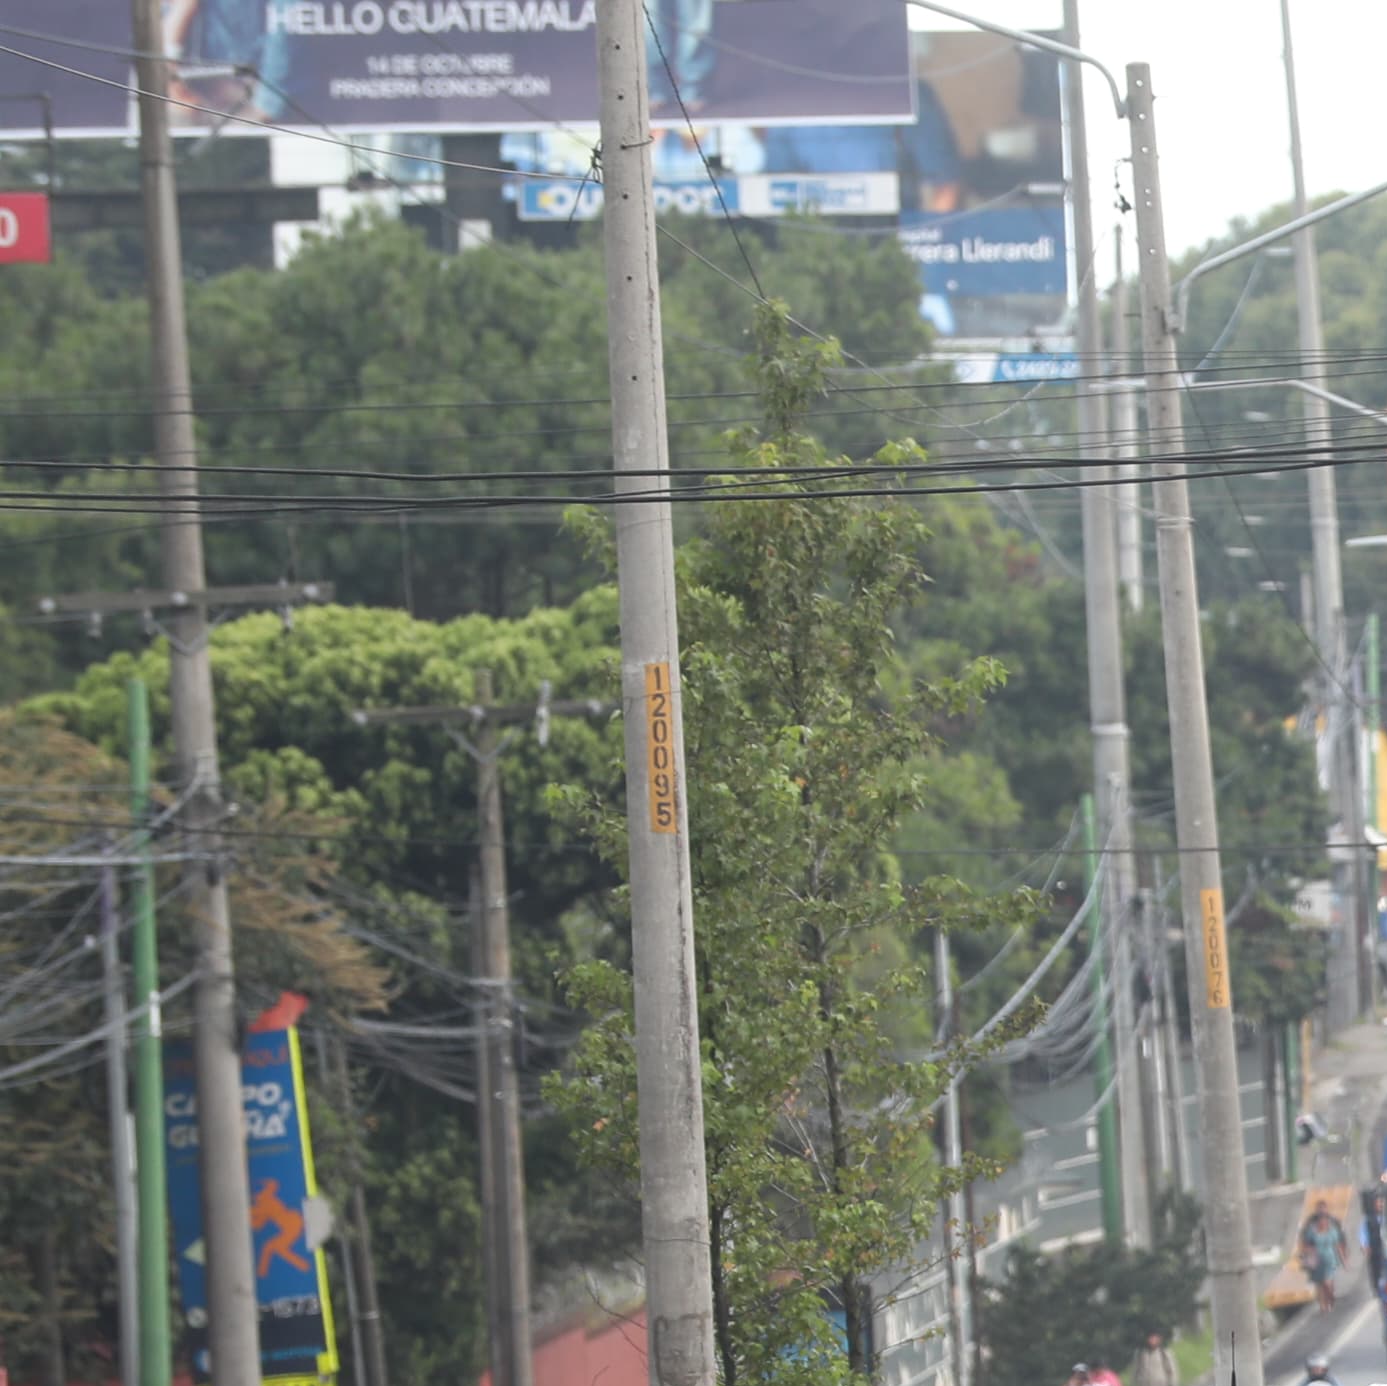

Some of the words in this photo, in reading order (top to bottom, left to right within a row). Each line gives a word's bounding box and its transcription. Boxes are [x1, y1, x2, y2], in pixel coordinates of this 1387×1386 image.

[266, 0, 385, 35] HELLO
[961, 236, 1055, 263] Llerandi
[651, 665, 672, 828] 120095
[1207, 895, 1224, 1005] 120076
